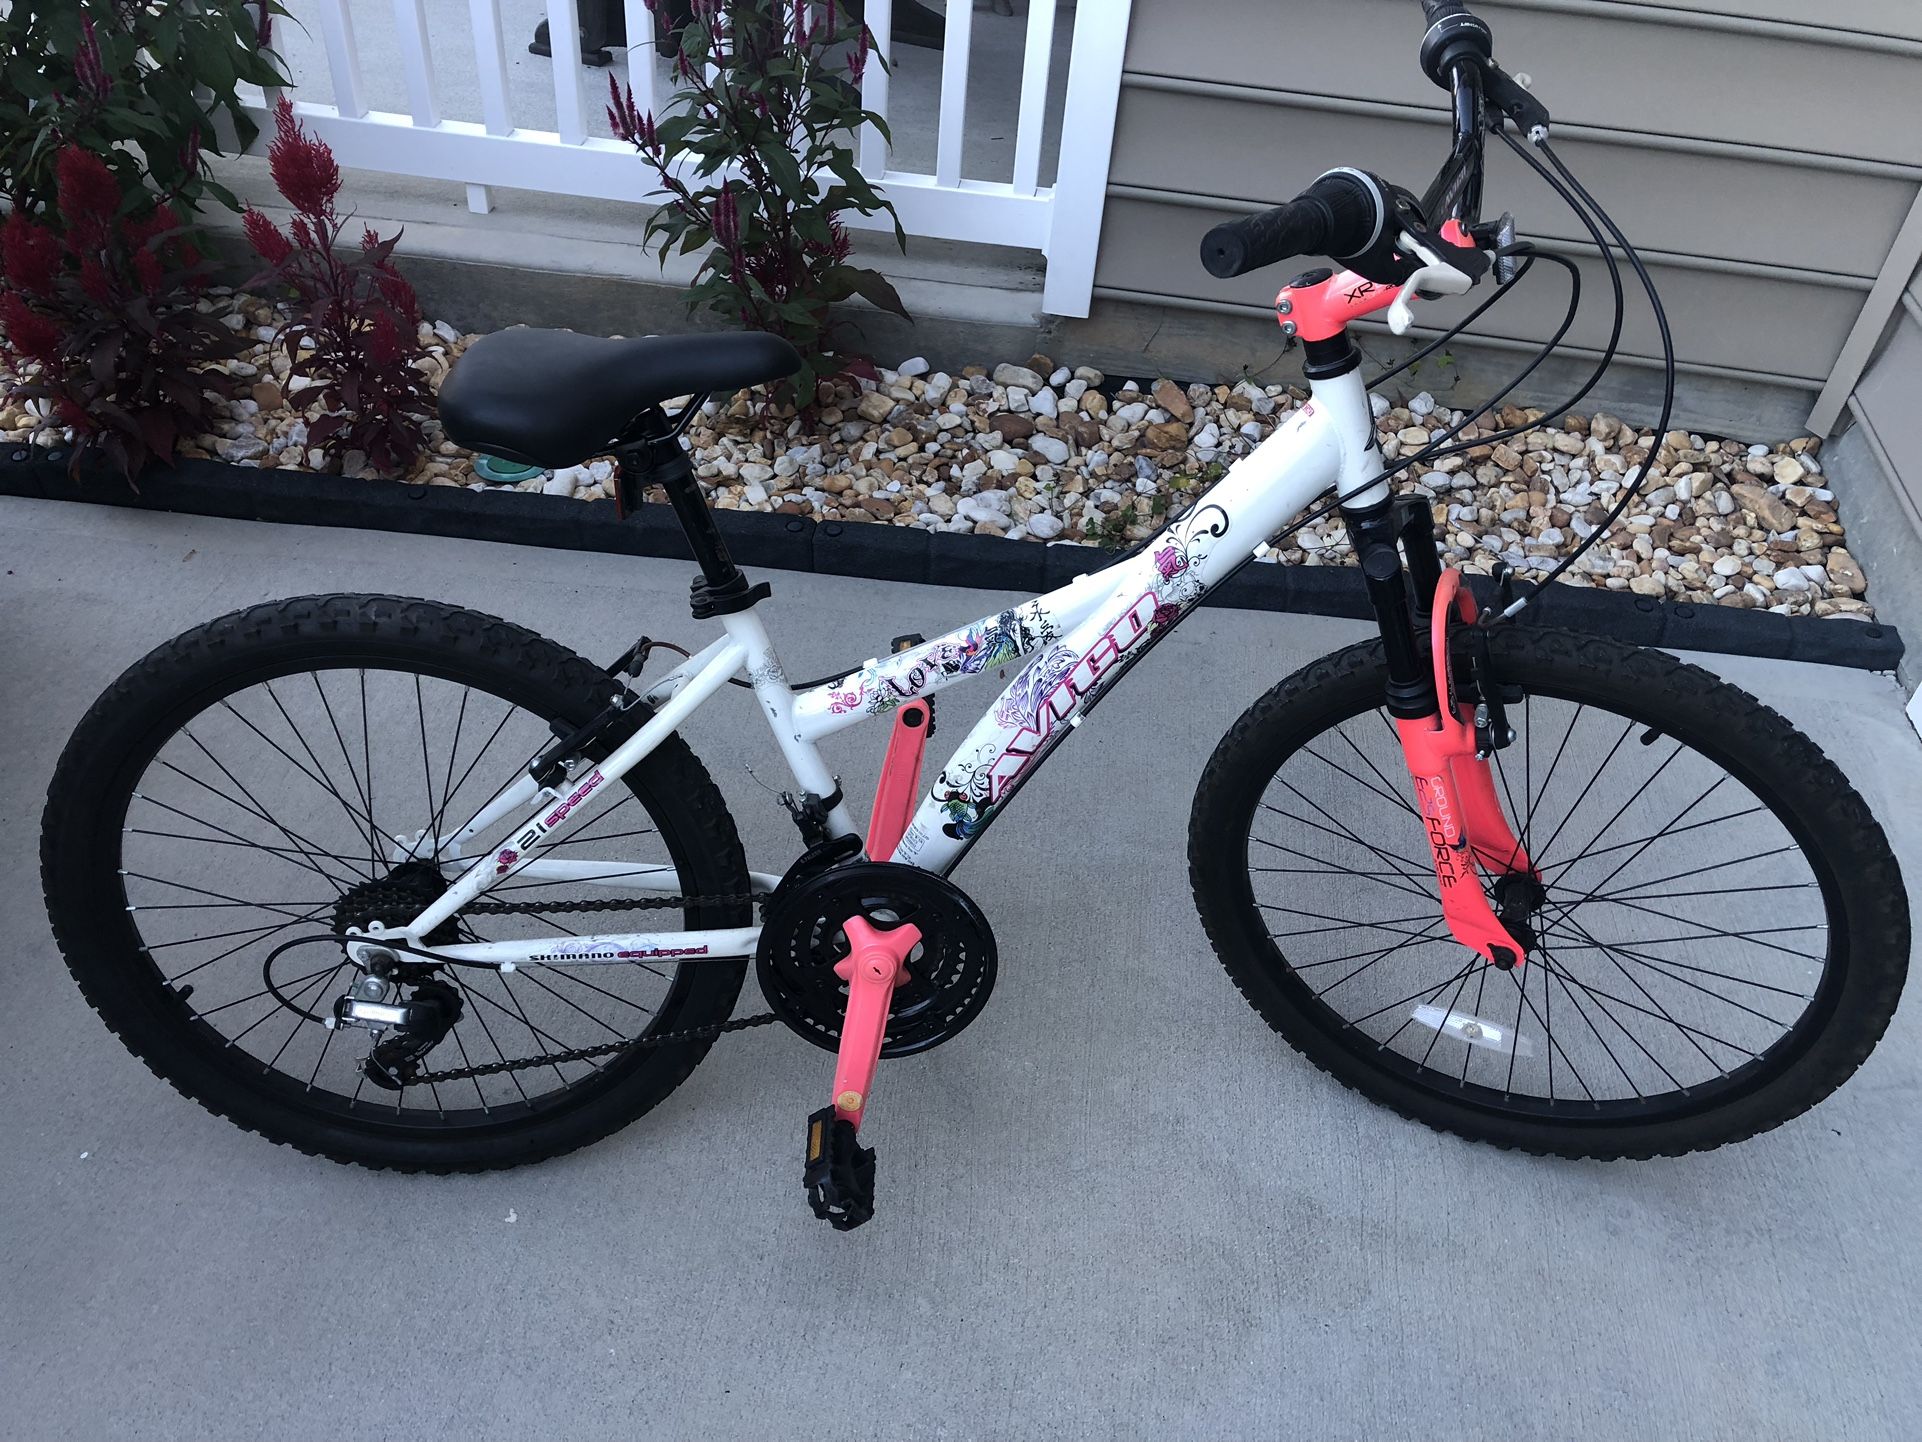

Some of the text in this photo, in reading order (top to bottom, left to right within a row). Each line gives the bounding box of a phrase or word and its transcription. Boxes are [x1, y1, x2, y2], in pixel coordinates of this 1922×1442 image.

[1343, 281, 1376, 305] XR
[986, 591, 1160, 803] AVIGO
[516, 770, 605, 851] 21 speed
[1430, 775, 1456, 838] GROUND
[1425, 816, 1458, 888] FORCE
[617, 945, 708, 959] equipped
